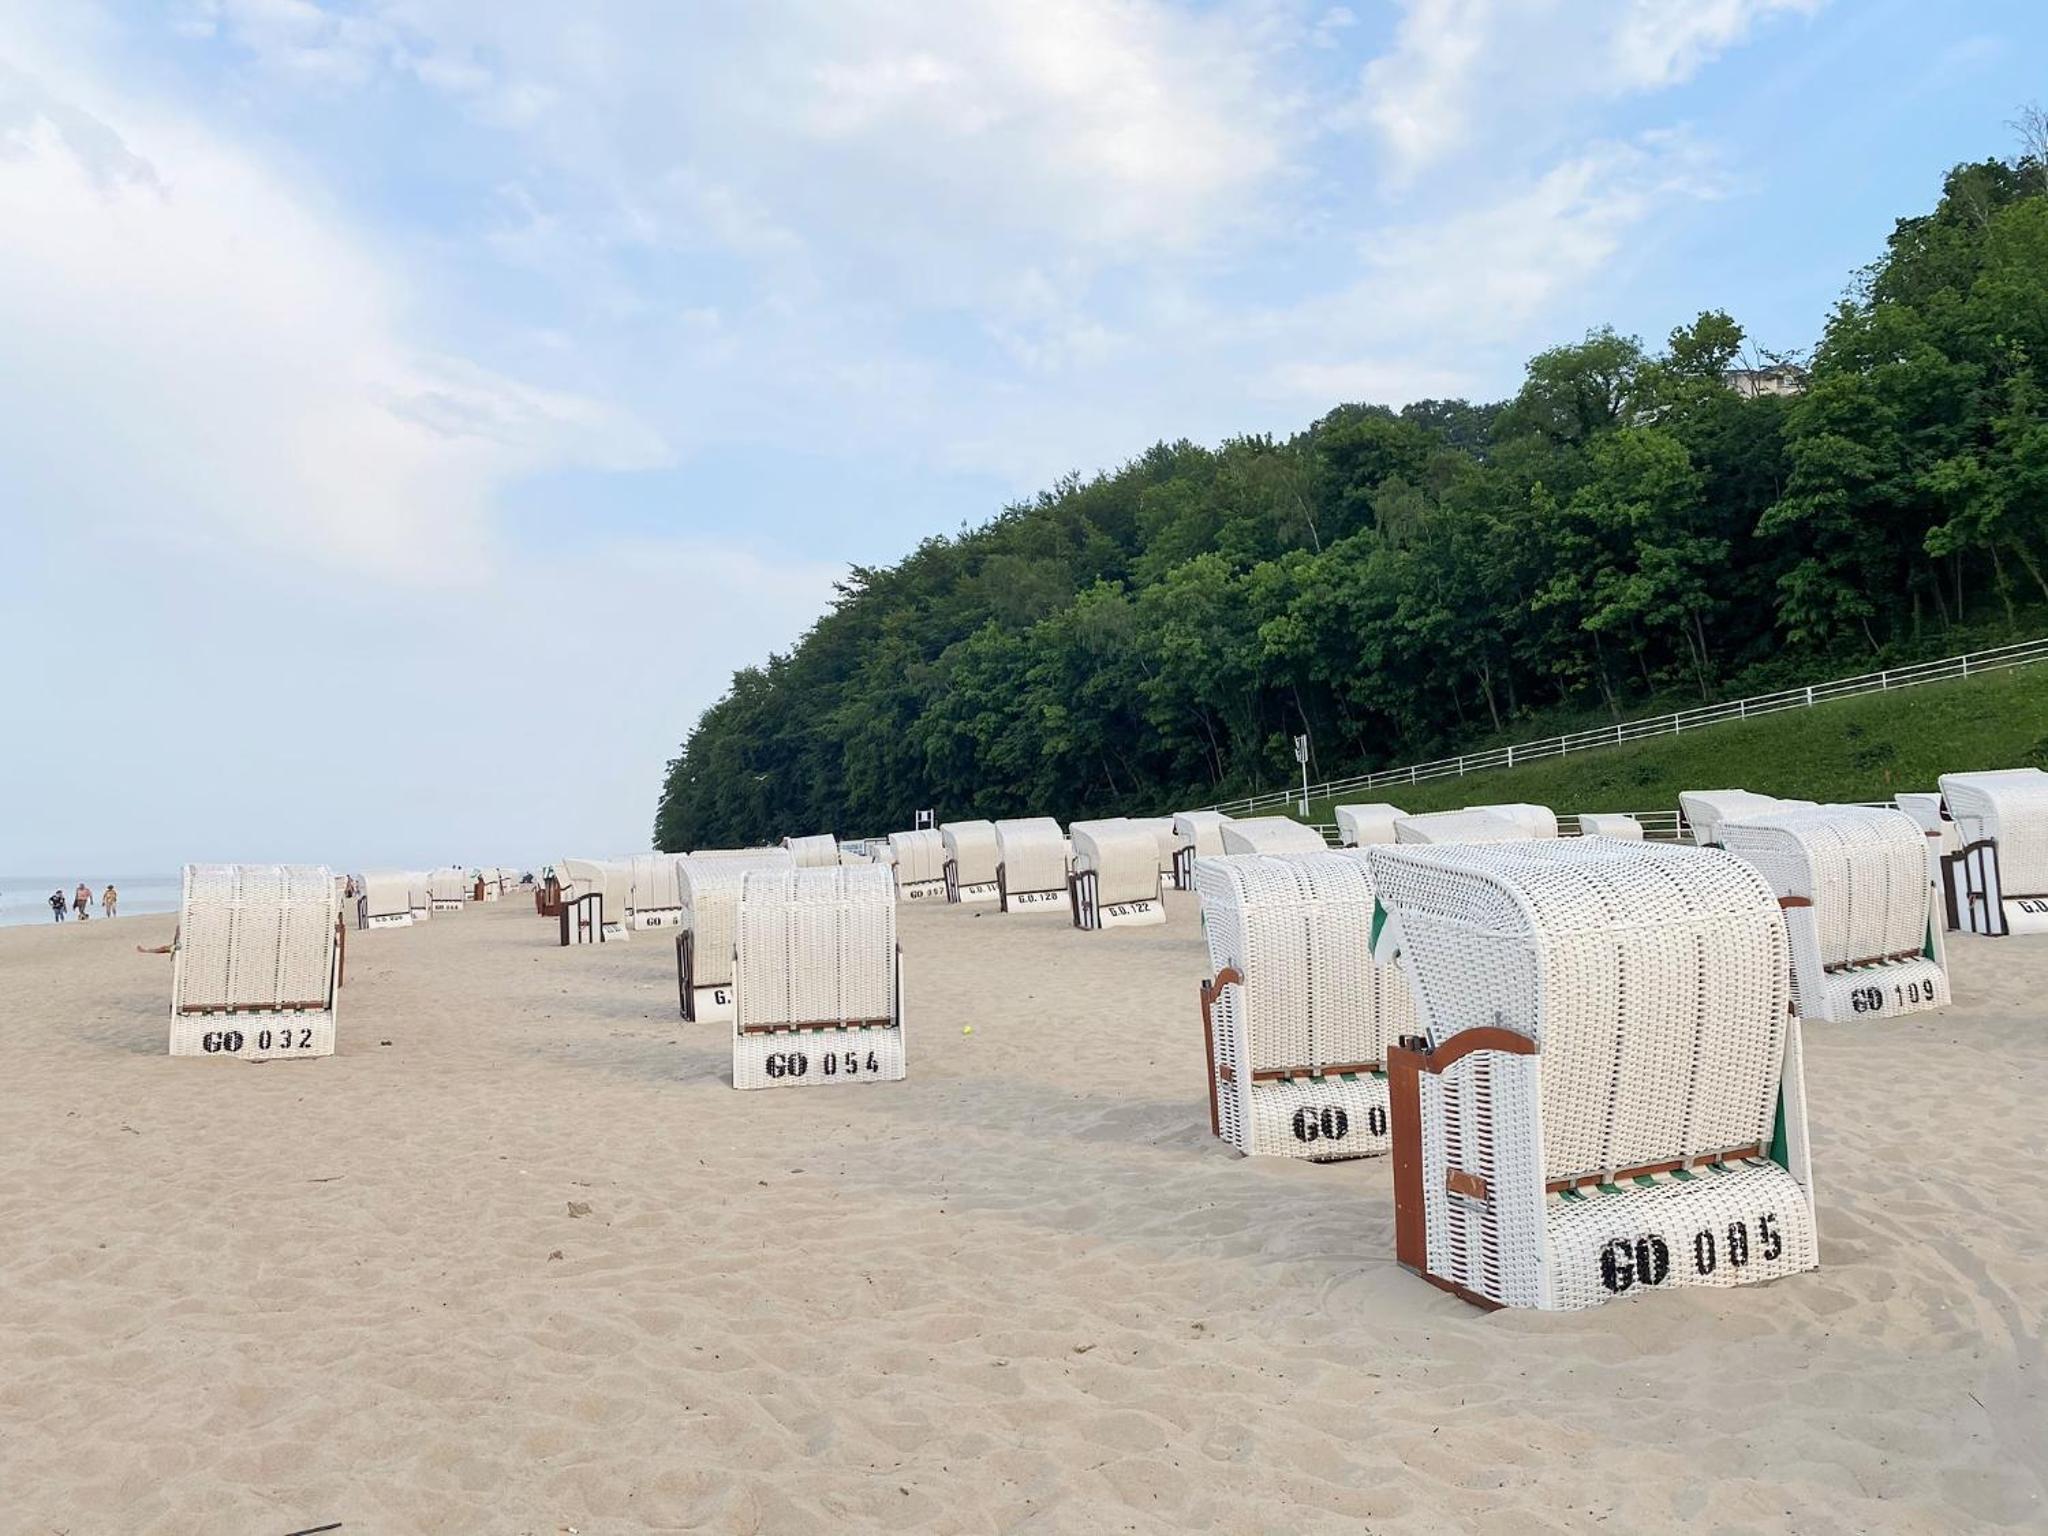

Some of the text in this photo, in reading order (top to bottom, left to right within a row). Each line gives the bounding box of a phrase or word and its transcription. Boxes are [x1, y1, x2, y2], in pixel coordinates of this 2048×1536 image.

[910, 890, 923, 899] GO
[646, 917, 661, 926] GO
[1109, 902, 1152, 917] G.O. 122
[1851, 979, 1934, 1013] GO 109
[203, 1028, 312, 1053] GO 032
[765, 1051, 879, 1078] GO 054
[1292, 1105, 1349, 1142] GO
[1600, 1233, 1669, 1293] GO
